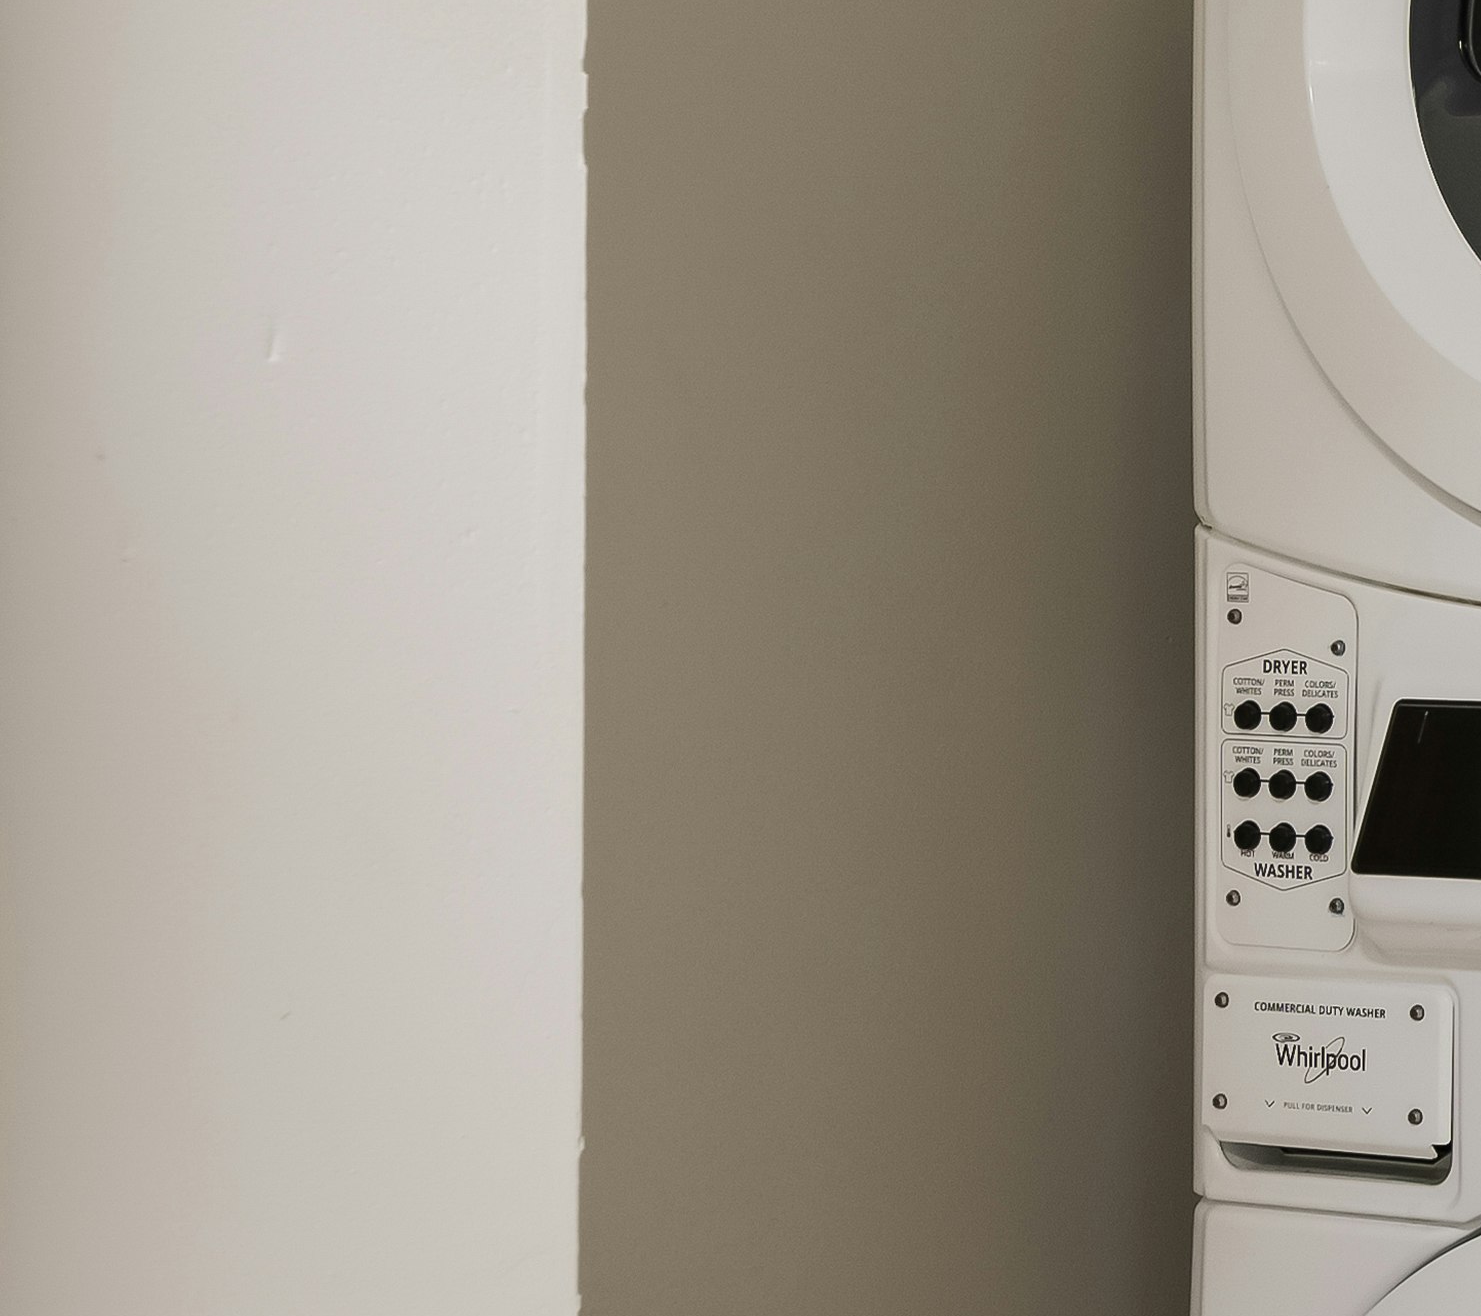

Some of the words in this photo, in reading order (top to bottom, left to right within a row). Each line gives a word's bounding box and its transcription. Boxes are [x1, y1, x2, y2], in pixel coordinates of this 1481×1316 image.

[1263, 659, 1308, 675] DRYER
[1274, 679, 1294, 687] PERM
[1235, 687, 1262, 696] WHITES
[1274, 688, 1295, 697] PRESS
[1302, 689, 1339, 698] DELICATES
[1232, 746, 1264, 755] COTTON/
[1273, 748, 1293, 757] PERM
[1304, 750, 1335, 758] COLORS/
[1235, 756, 1261, 764] WHITES
[1273, 757, 1294, 766] PRESS
[1301, 759, 1338, 768] DELICATES
[1240, 849, 1255, 858] HOT
[1309, 854, 1329, 862] COLD
[1254, 862, 1313, 880] WASHER
[1254, 1001, 1316, 1015] COMMERCIAL
[1319, 1005, 1344, 1016] DUTY
[1346, 1007, 1386, 1019] WASHER
[1275, 1043, 1366, 1076] Whirlpool
[1284, 1102, 1300, 1110] PULL
[1302, 1103, 1315, 1111] FOR
[1317, 1104, 1353, 1113] DISPENSER
